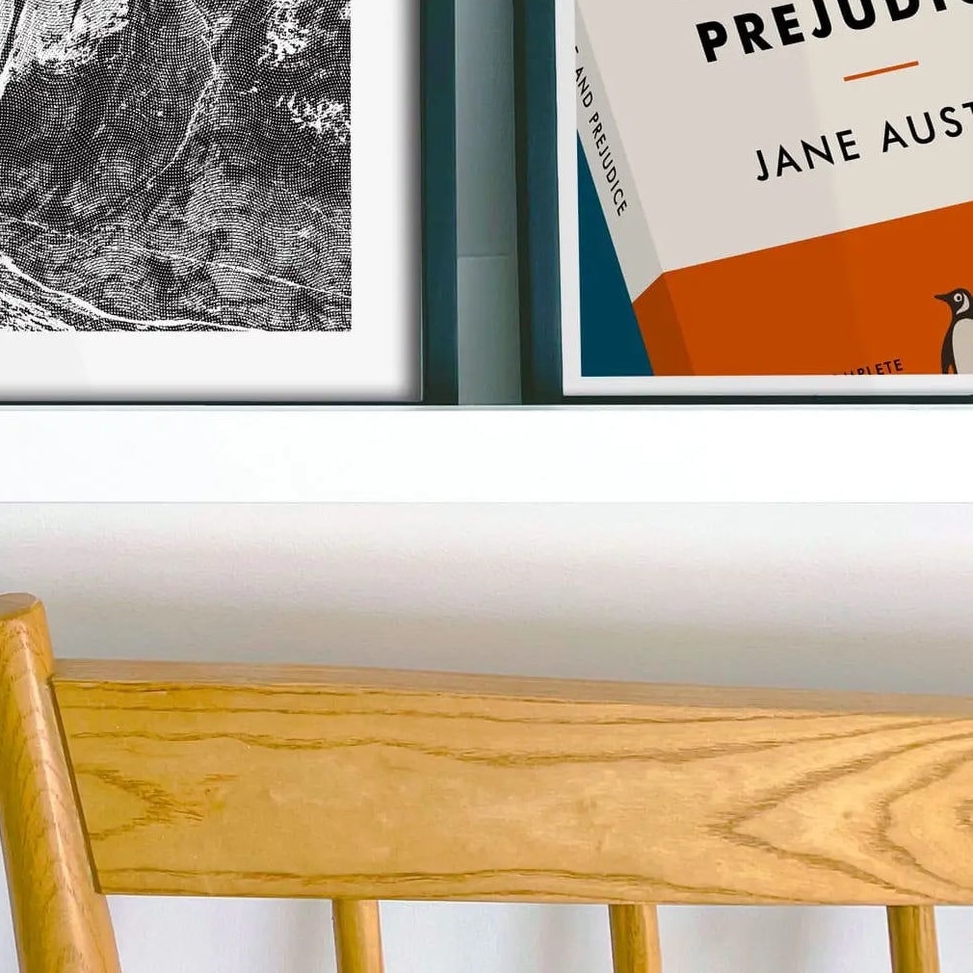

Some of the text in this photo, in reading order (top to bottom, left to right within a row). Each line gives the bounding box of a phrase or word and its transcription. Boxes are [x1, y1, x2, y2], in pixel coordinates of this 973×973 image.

[575, 66, 629, 217] AND PREJUDICE
[756, 129, 861, 182] JANE
